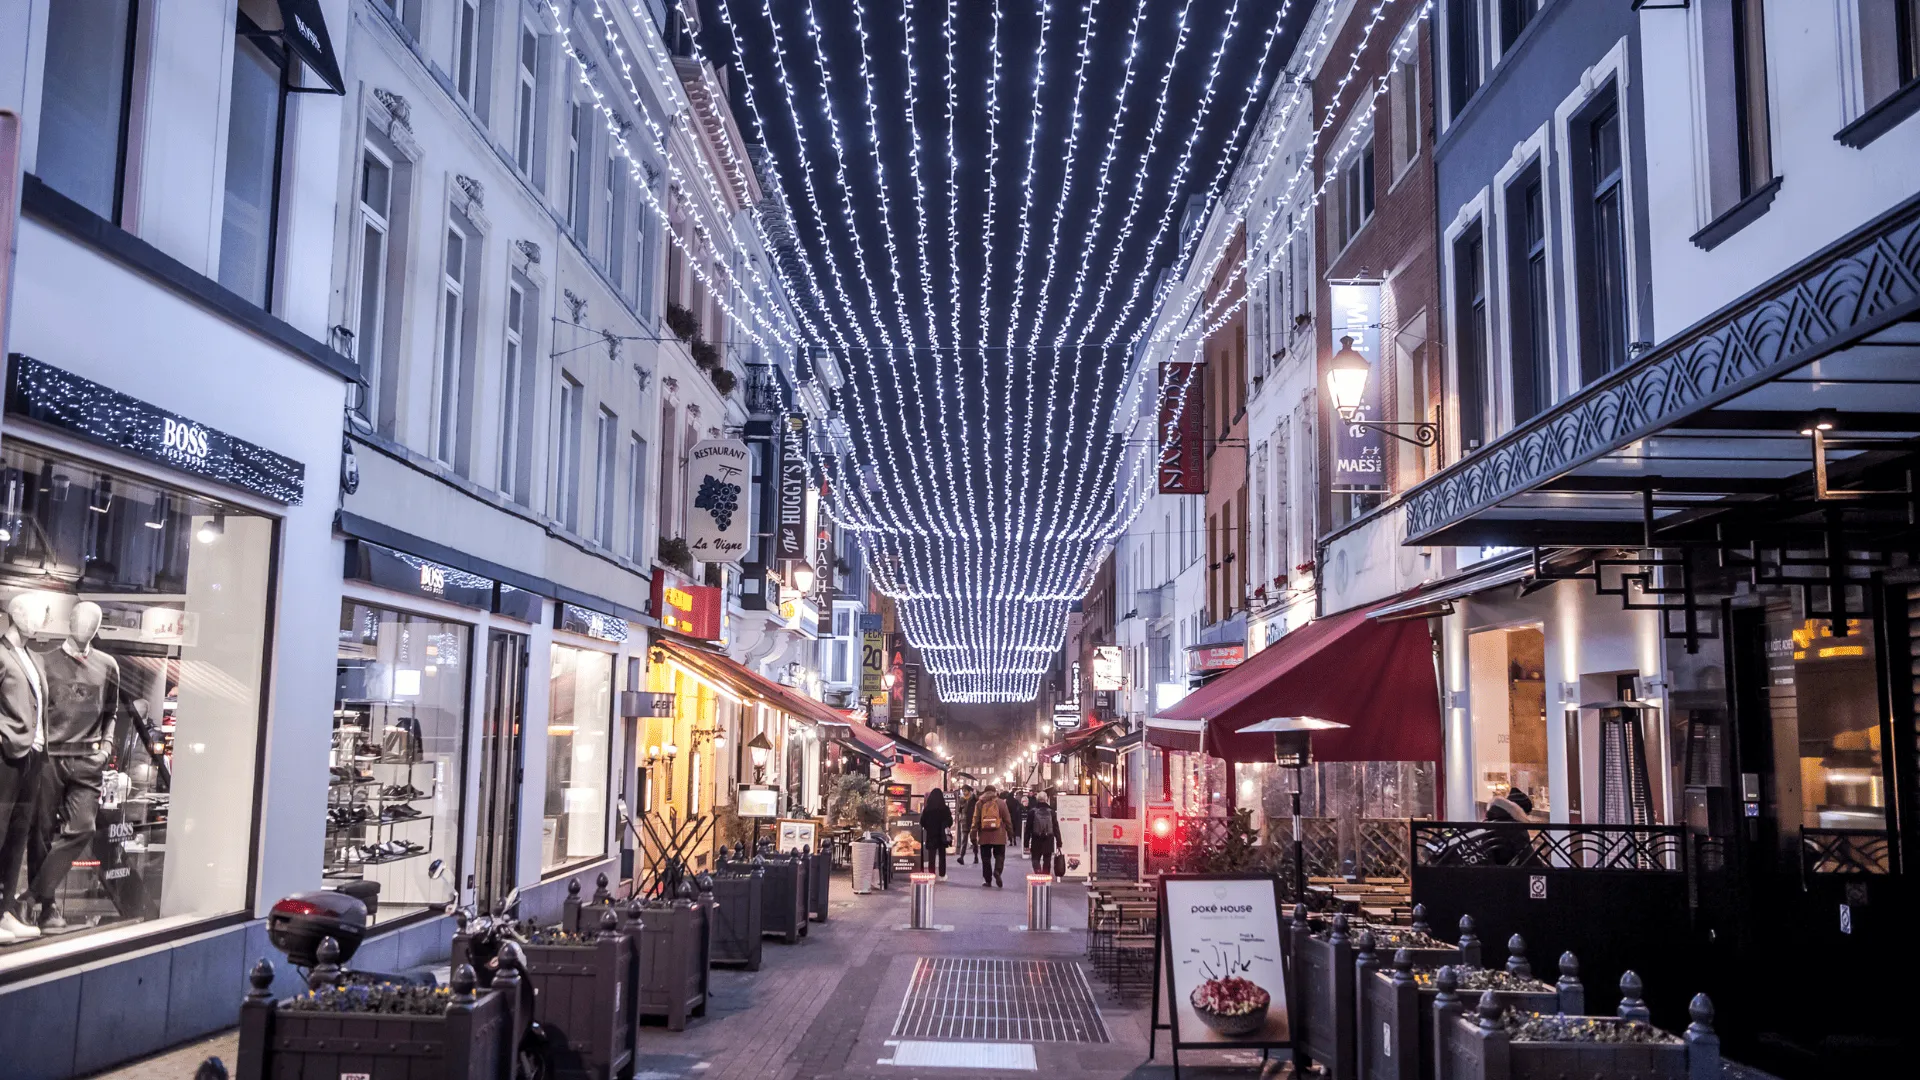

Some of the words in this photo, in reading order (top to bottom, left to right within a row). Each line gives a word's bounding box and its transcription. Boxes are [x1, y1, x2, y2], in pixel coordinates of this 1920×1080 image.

[163, 417, 208, 458] BOSS
[694, 446, 746, 460] RESTAURANT
[1337, 459, 1376, 472] MAES
[782, 465, 802, 525] HUGGY'S
[692, 537, 708, 550] La
[713, 538, 743, 554] Vigne
[783, 528, 799, 553] The
[421, 564, 445, 589] BOSS
[816, 538, 829, 607] BACHA
[863, 645, 882, 670] 20
[109, 822, 134, 838] BOSS
[105, 867, 131, 880] MEISSEN
